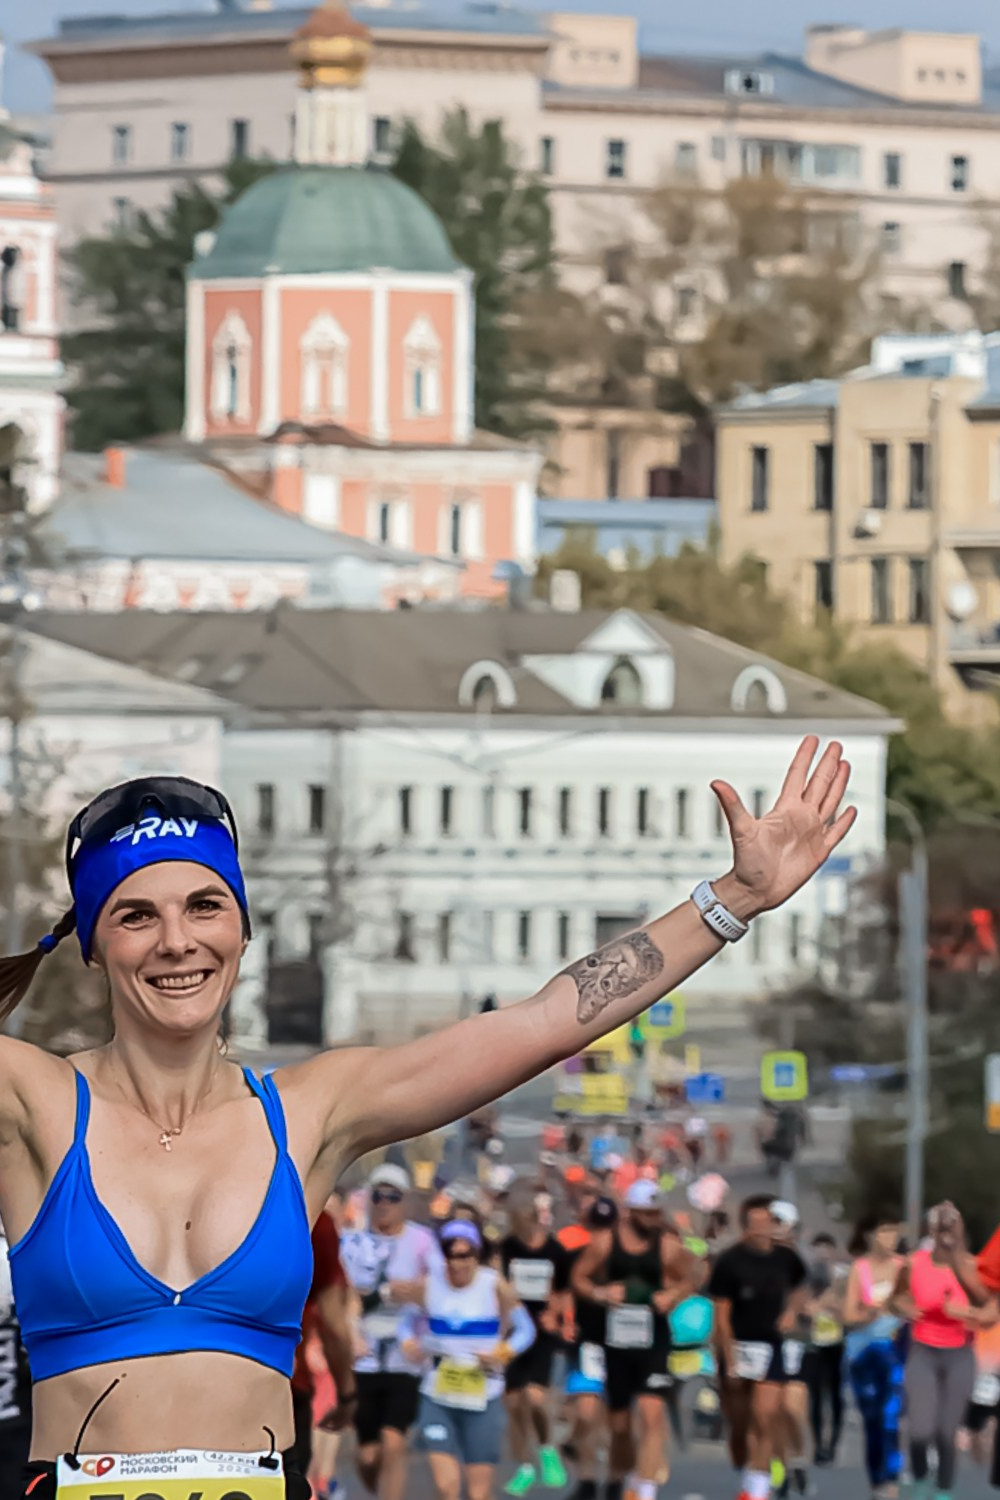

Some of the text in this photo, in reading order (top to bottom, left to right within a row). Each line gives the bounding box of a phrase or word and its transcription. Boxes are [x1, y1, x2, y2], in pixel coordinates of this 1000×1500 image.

[131, 816, 199, 846] RAY
[119, 1455, 198, 1467] МОСКОВСКИЙ
[119, 1465, 178, 1475] МАРАФОН
